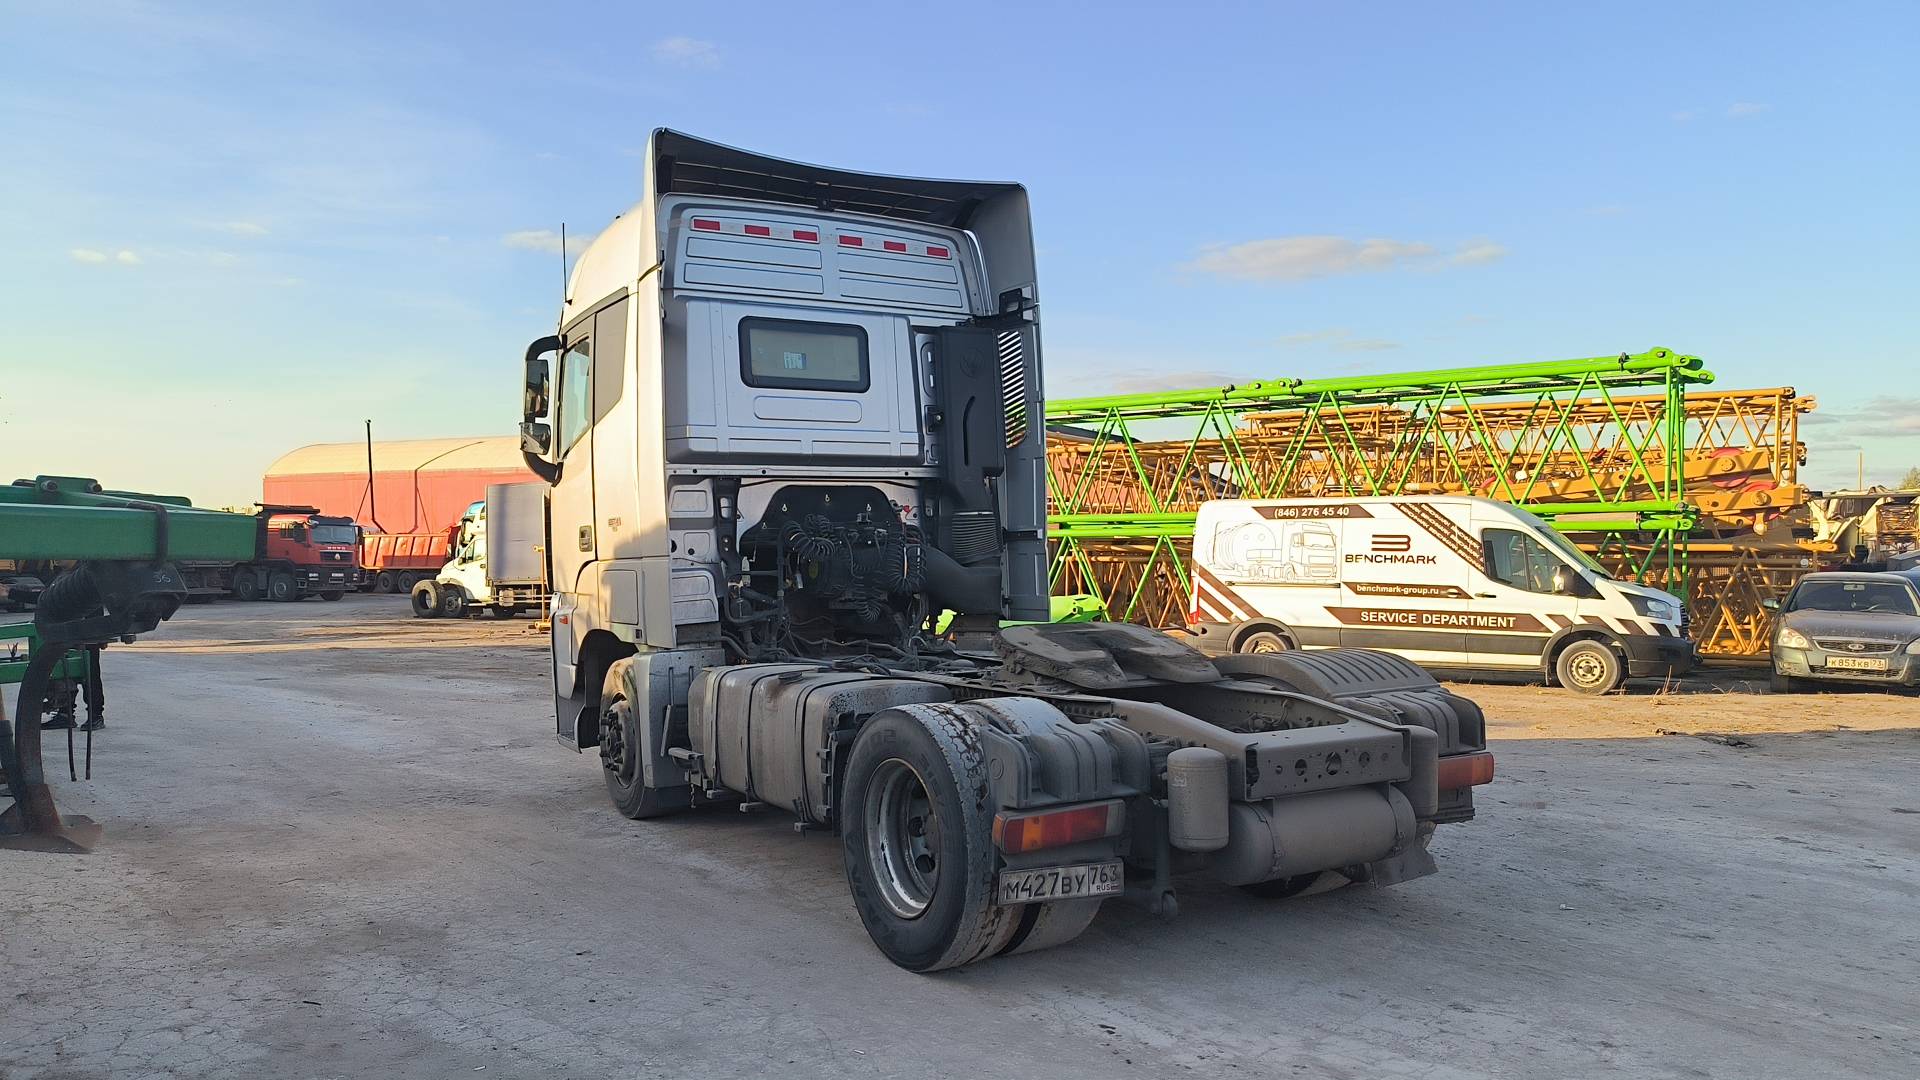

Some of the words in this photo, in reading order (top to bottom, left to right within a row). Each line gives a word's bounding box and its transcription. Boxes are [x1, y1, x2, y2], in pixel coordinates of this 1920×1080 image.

[1274, 508, 1299, 519] (846)
[1302, 507, 1319, 517] 276
[1322, 507, 1334, 516] 45
[1336, 507, 1350, 516] 40
[1344, 554, 1437, 565] BENCHMARK
[1356, 584, 1439, 595] benchmark-group.ru
[1360, 611, 1417, 624] SERVICE
[1422, 614, 1516, 628] DEPARTMENT
[1090, 865, 1118, 885] 763
